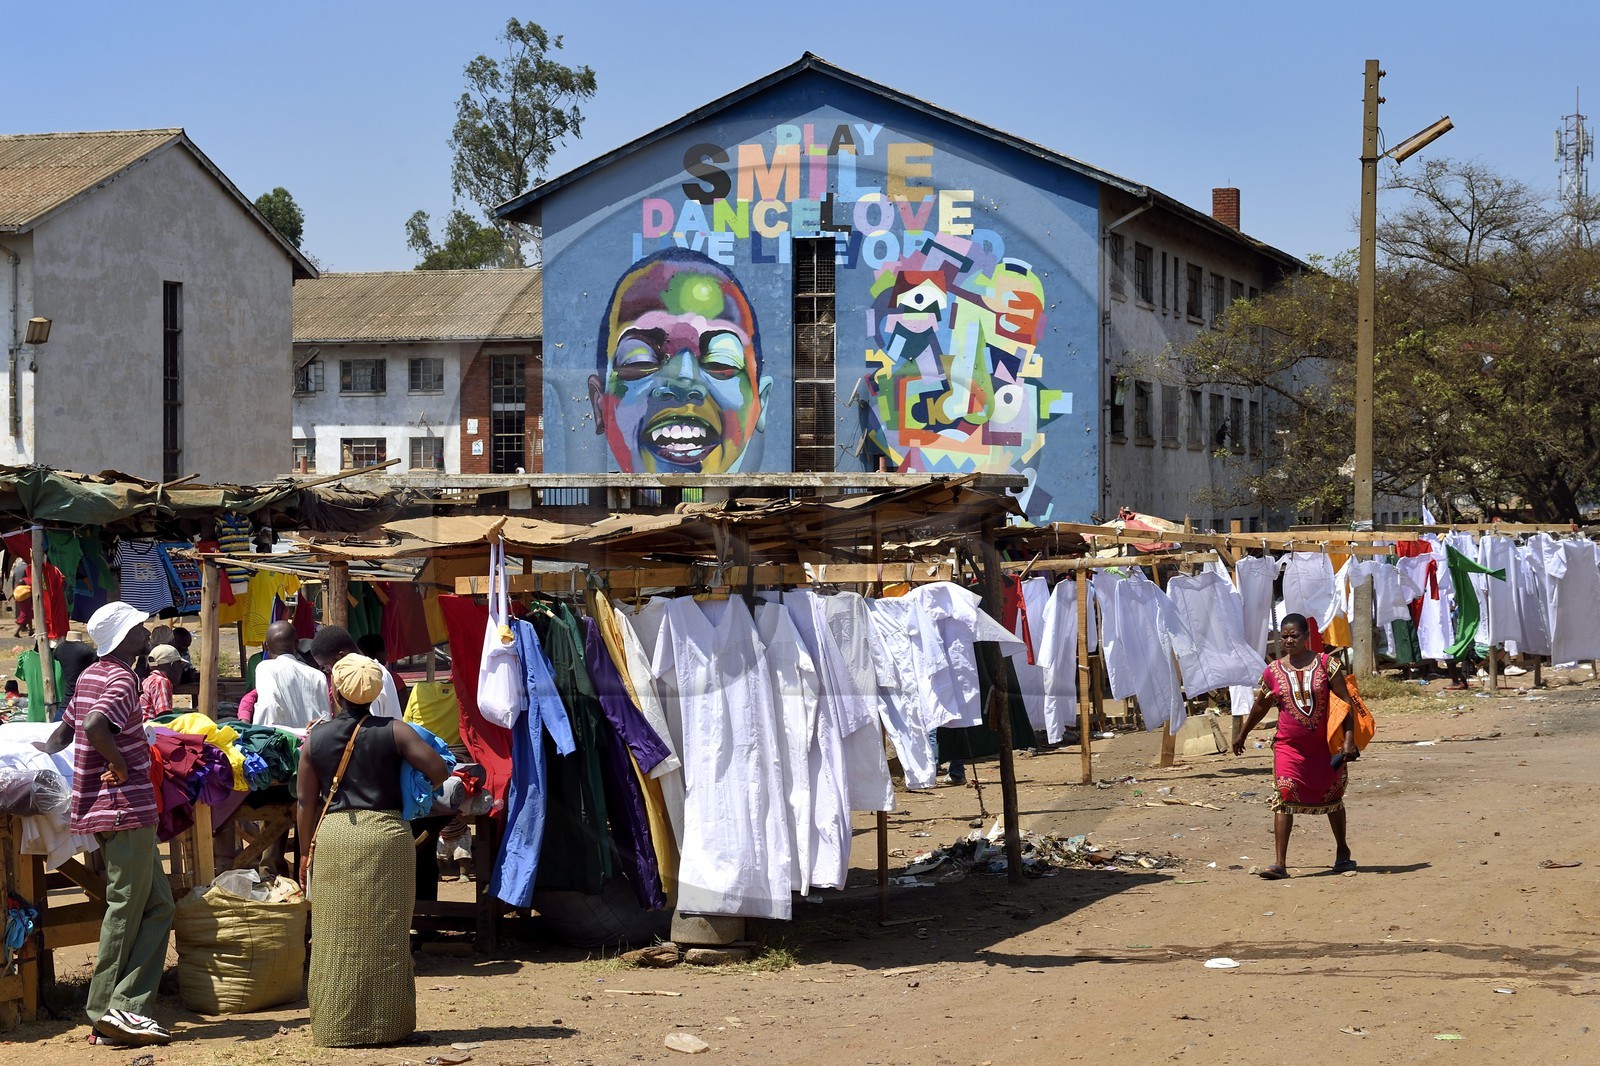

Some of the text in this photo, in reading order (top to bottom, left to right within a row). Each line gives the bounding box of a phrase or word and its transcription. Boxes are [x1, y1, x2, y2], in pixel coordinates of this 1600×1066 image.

[776, 123, 885, 156] PLAY
[682, 142, 934, 205] SMILE
[642, 190, 975, 239] DANCE LOVE
[751, 230, 849, 267] LIE
